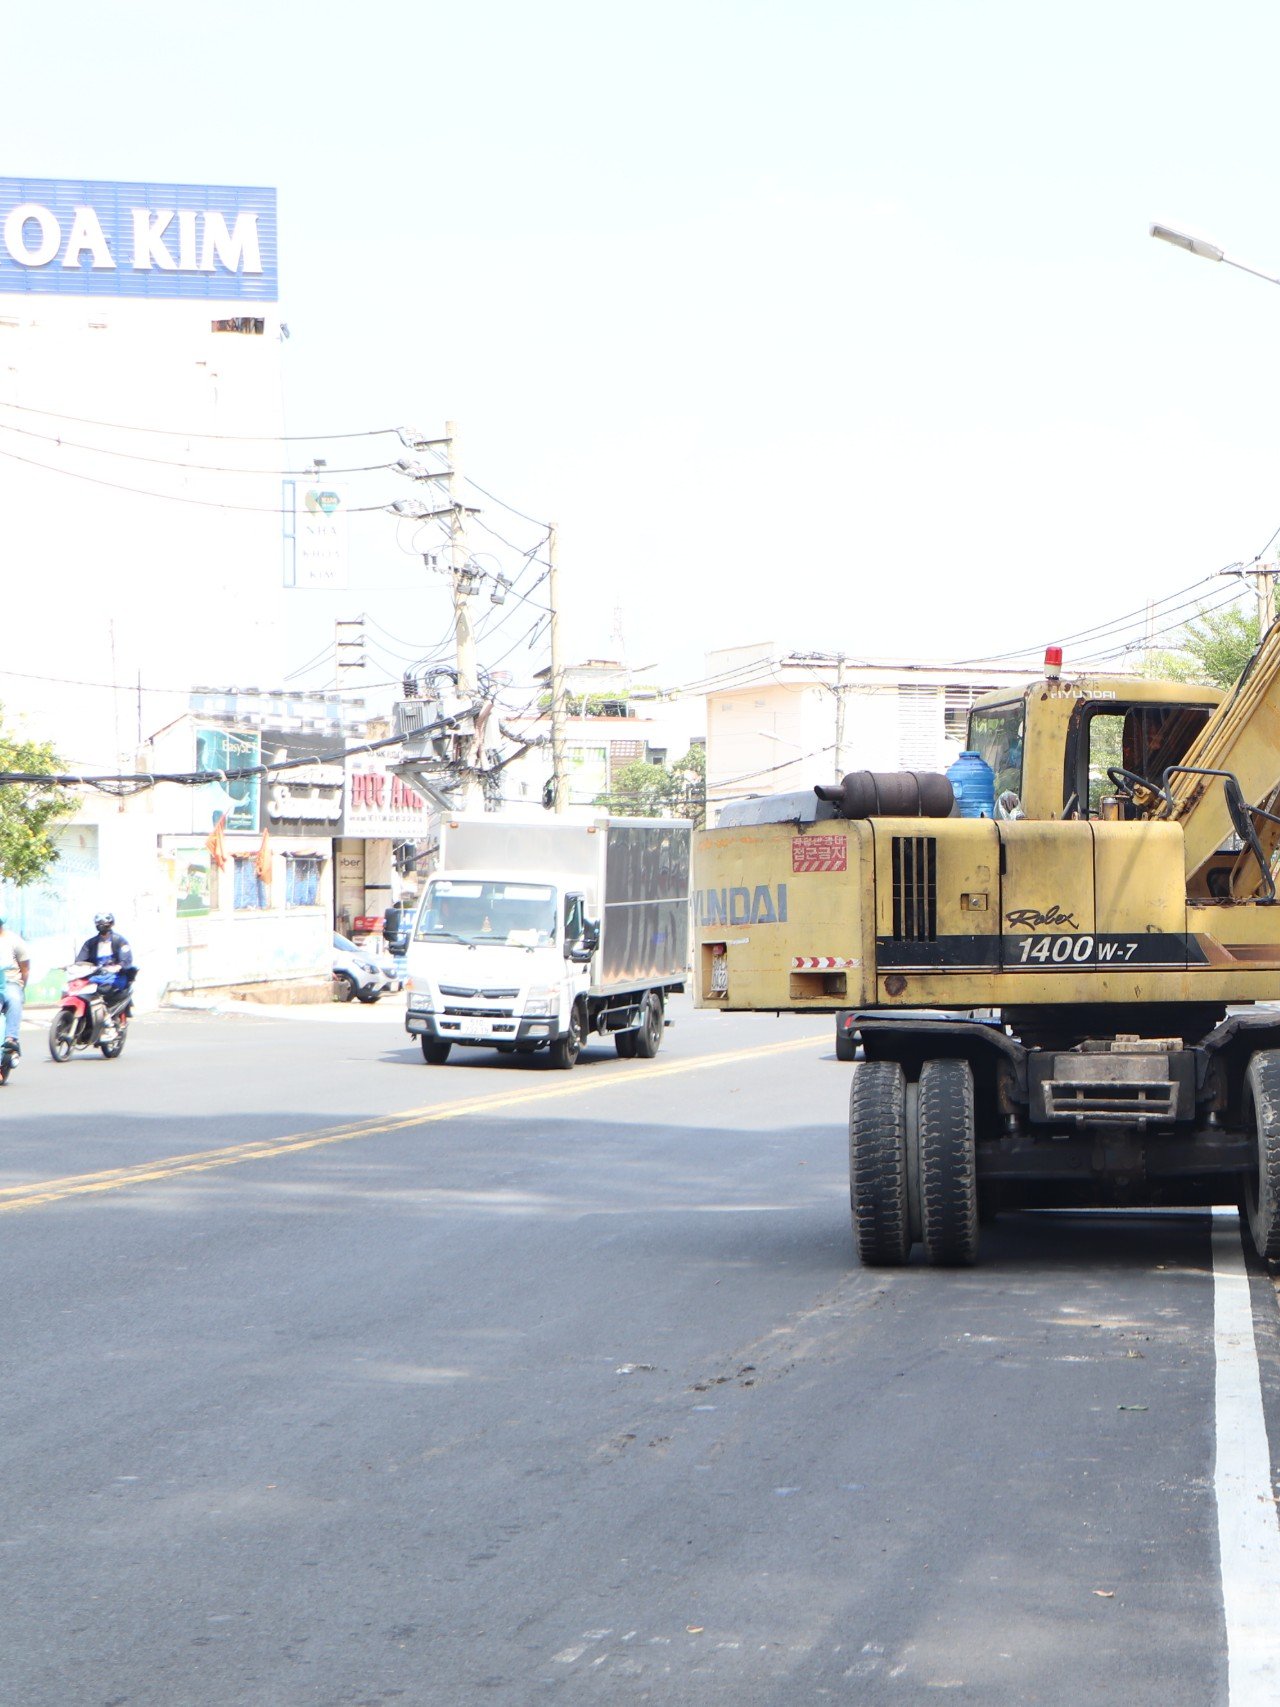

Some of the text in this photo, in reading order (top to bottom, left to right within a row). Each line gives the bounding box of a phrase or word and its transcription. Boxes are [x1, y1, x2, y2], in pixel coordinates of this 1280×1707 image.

[0, 205, 264, 273] OA KIM
[793, 846, 846, 860] 접근금지
[1005, 905, 1080, 931] Robex
[1018, 935, 1138, 962] 1400 W-7
